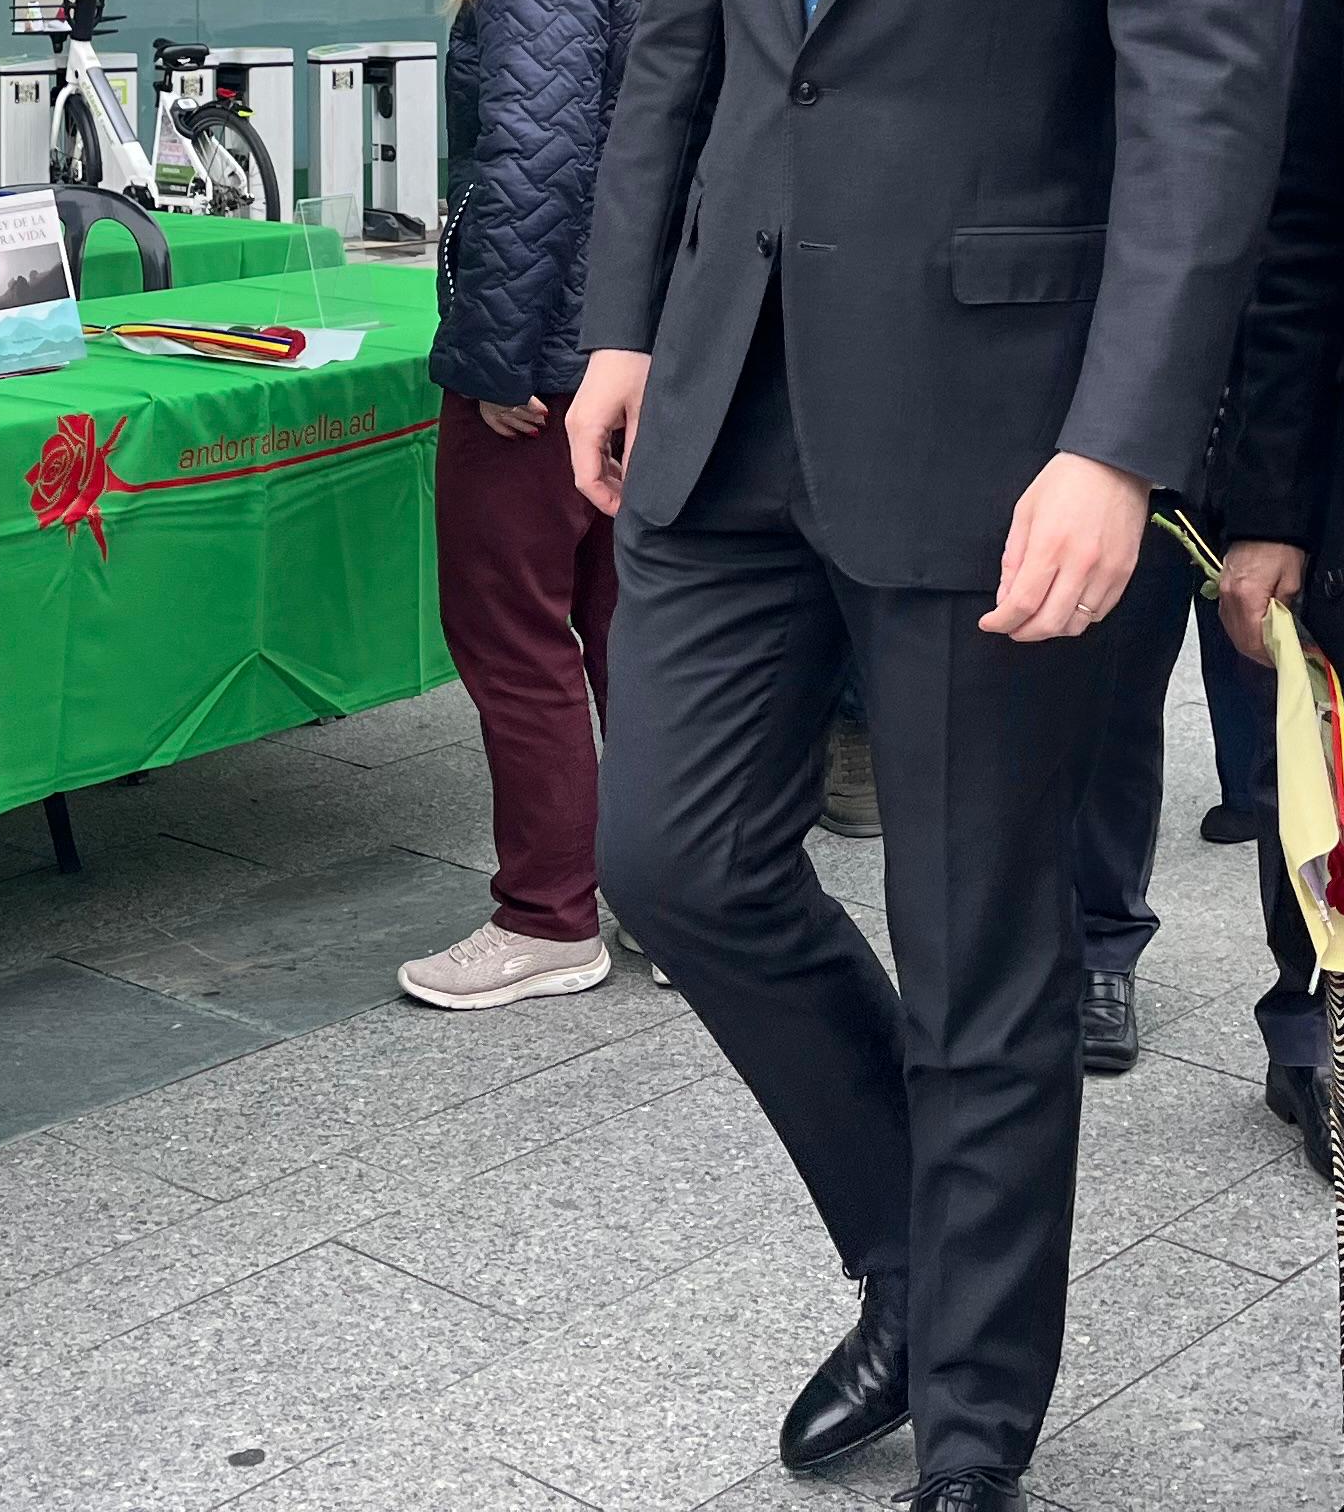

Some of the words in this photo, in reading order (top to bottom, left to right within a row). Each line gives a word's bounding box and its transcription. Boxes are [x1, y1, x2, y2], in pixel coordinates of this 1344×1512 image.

[13, 217, 27, 228] DE
[31, 214, 45, 226] LA
[18, 229, 47, 241] VIDA
